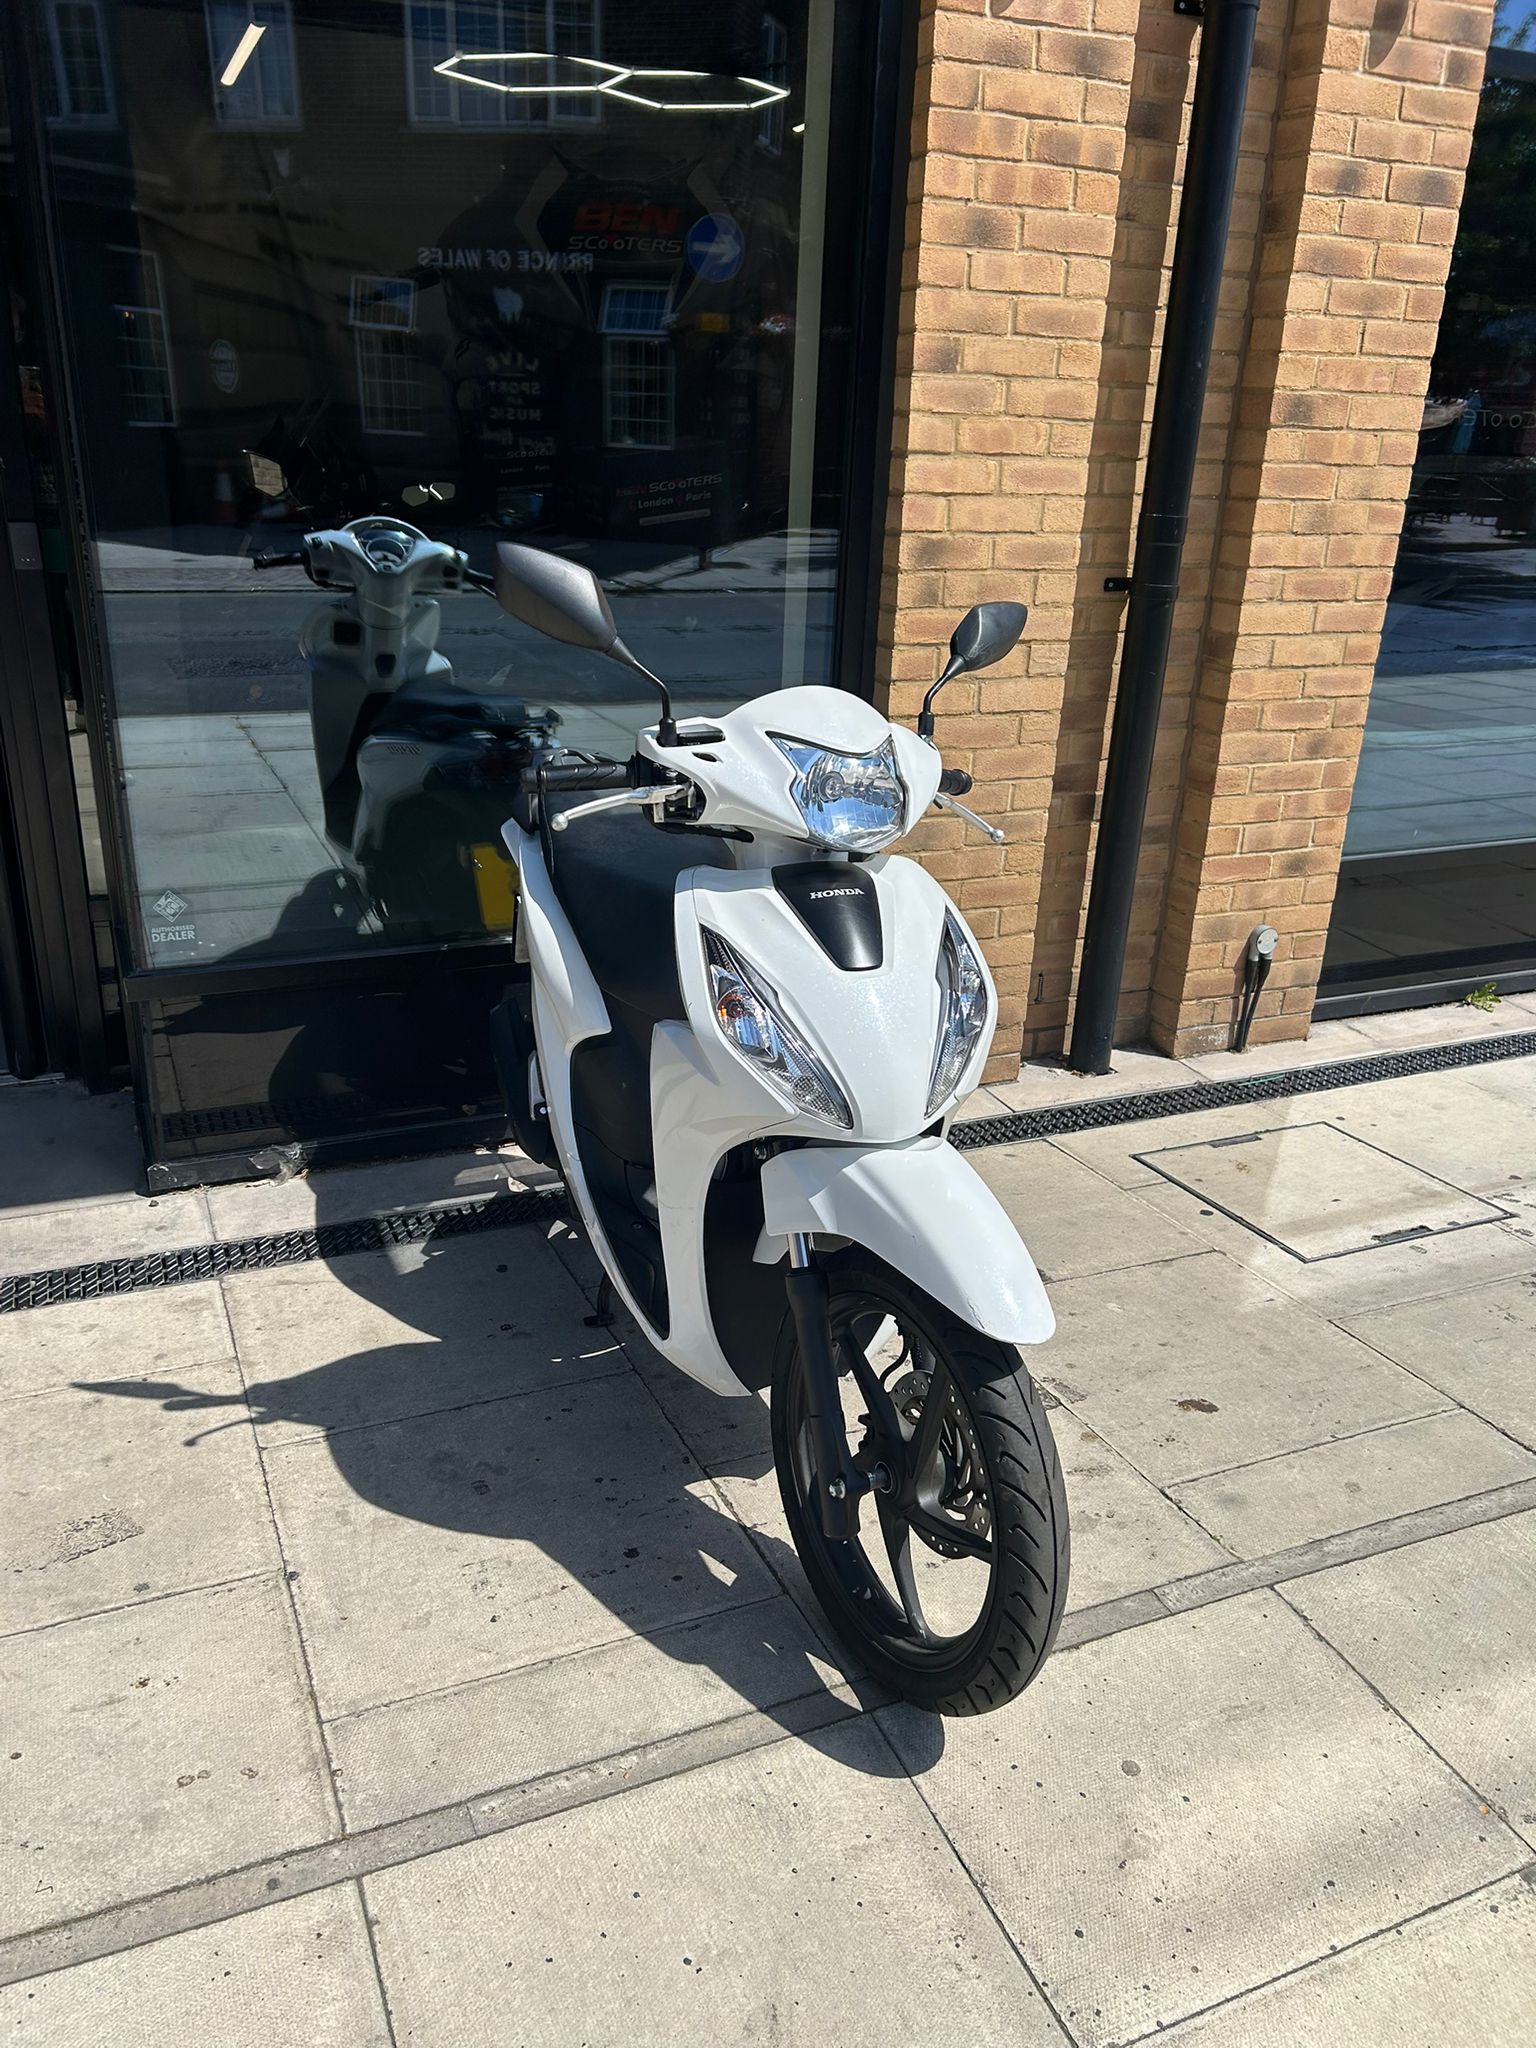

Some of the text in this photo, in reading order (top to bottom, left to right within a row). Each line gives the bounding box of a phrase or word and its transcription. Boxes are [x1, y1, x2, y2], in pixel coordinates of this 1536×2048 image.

[575, 202, 680, 235] BEN
[637, 496, 674, 510] London
[809, 887, 865, 900] HONDA
[151, 924, 196, 934] AUTHORISED
[151, 930, 196, 943] DEALER
